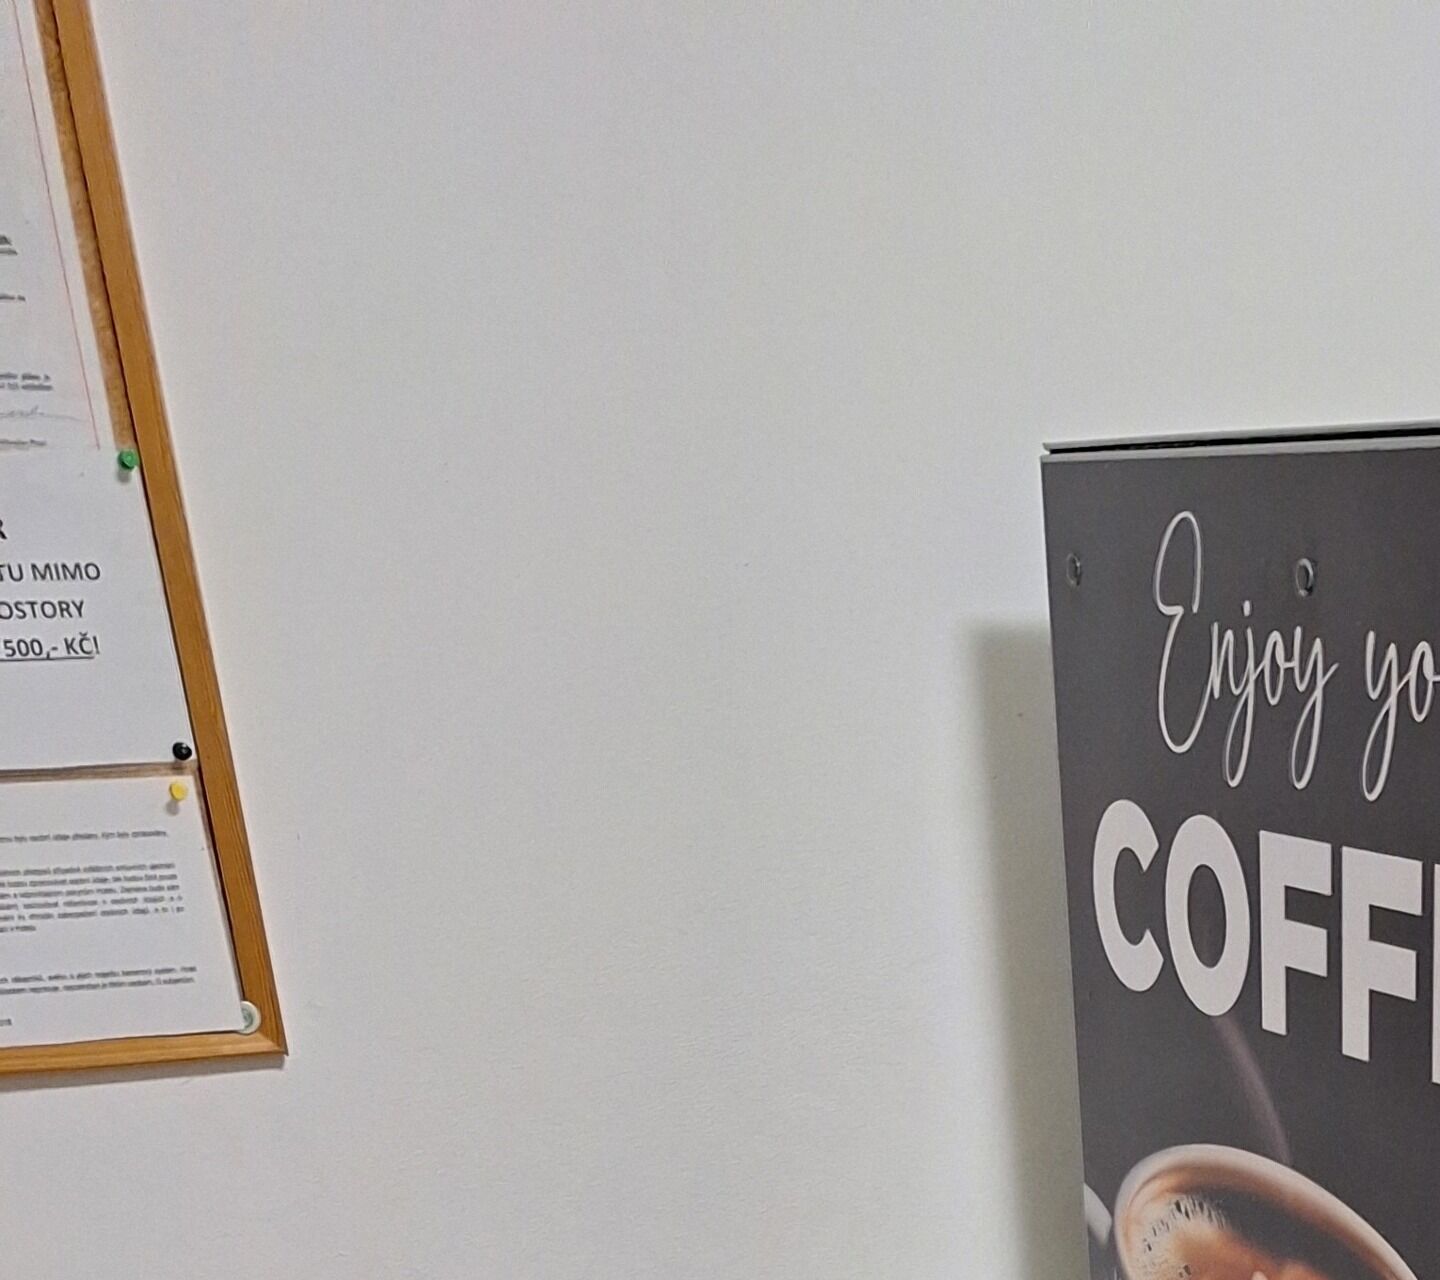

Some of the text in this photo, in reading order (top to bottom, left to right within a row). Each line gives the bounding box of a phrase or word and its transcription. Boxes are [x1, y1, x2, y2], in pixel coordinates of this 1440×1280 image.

[31, 562, 100, 582] MIMO
[0, 599, 84, 620] OSTORY
[4, 638, 58, 659] 500,-
[1153, 511, 1340, 788] Enjoy
